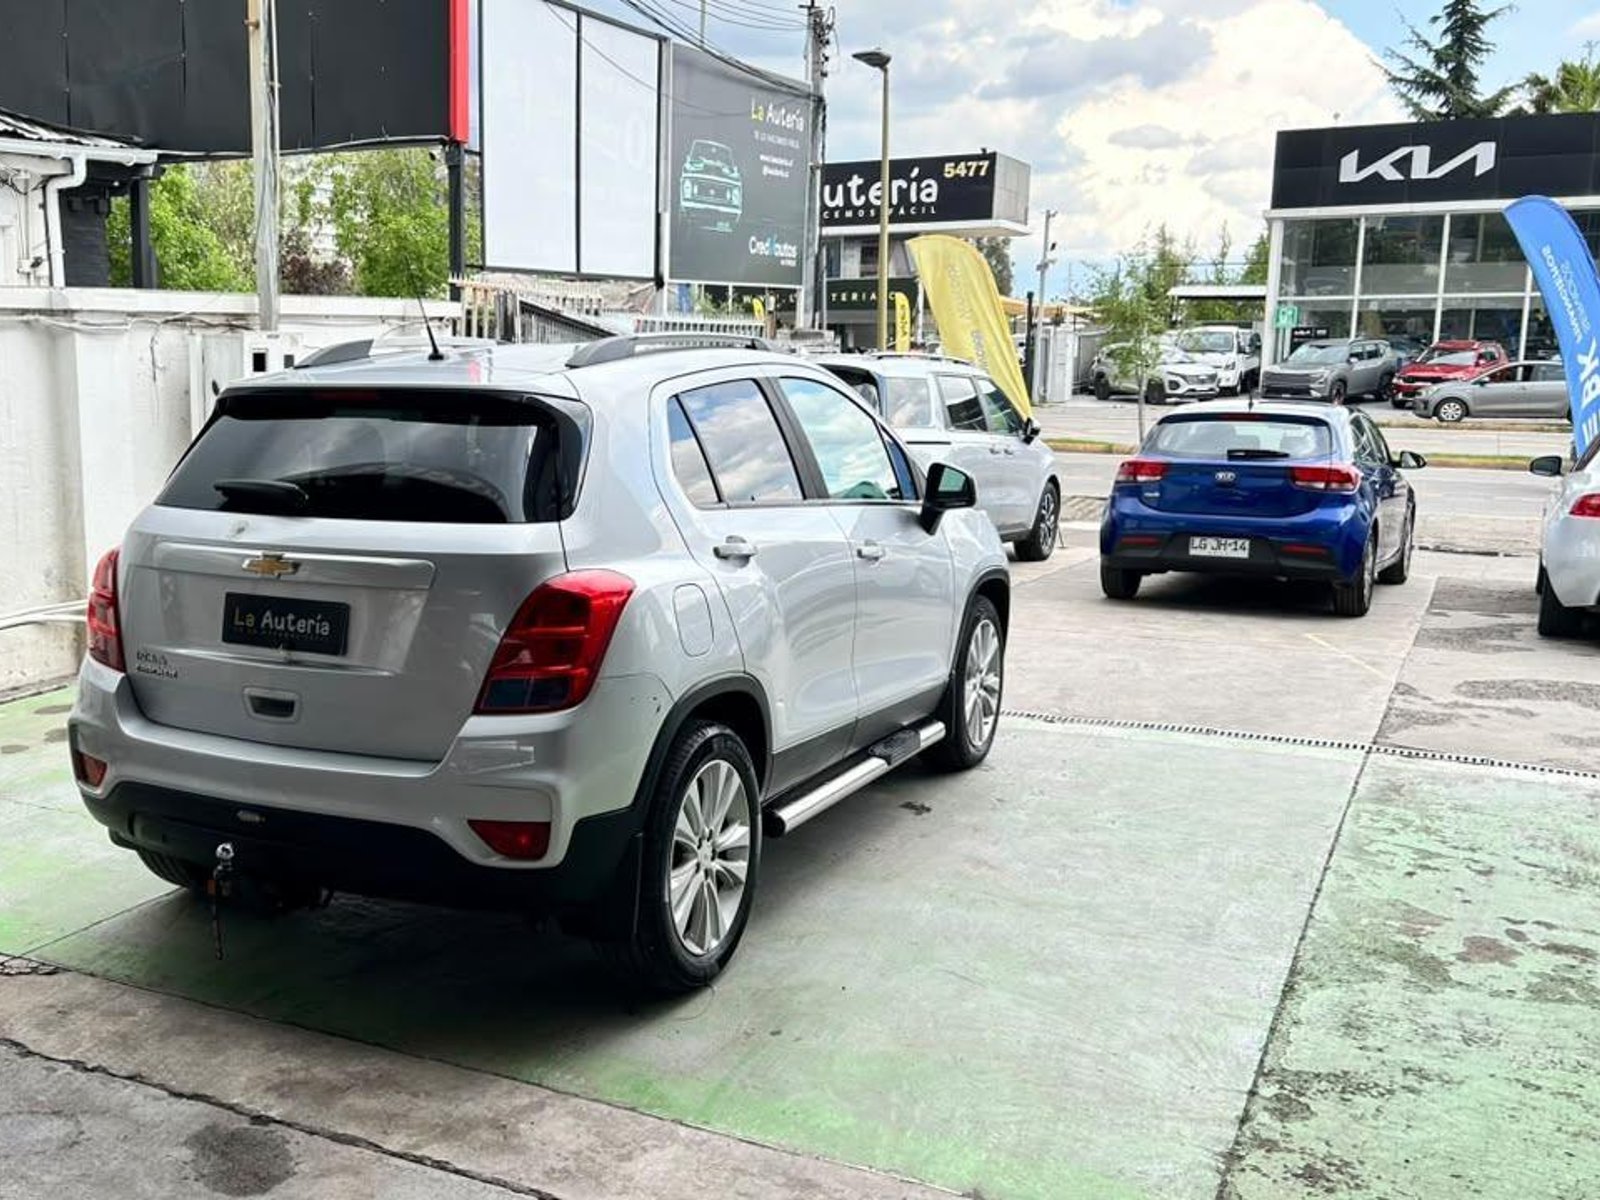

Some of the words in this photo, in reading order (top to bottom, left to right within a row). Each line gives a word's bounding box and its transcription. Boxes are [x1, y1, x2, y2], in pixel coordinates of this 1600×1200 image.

[751, 98, 764, 121] La
[766, 102, 804, 132] Autería
[943, 160, 989, 178] 5477
[1339, 141, 1497, 183] KIA
[234, 605, 255, 627] La
[260, 610, 330, 636] Autería
